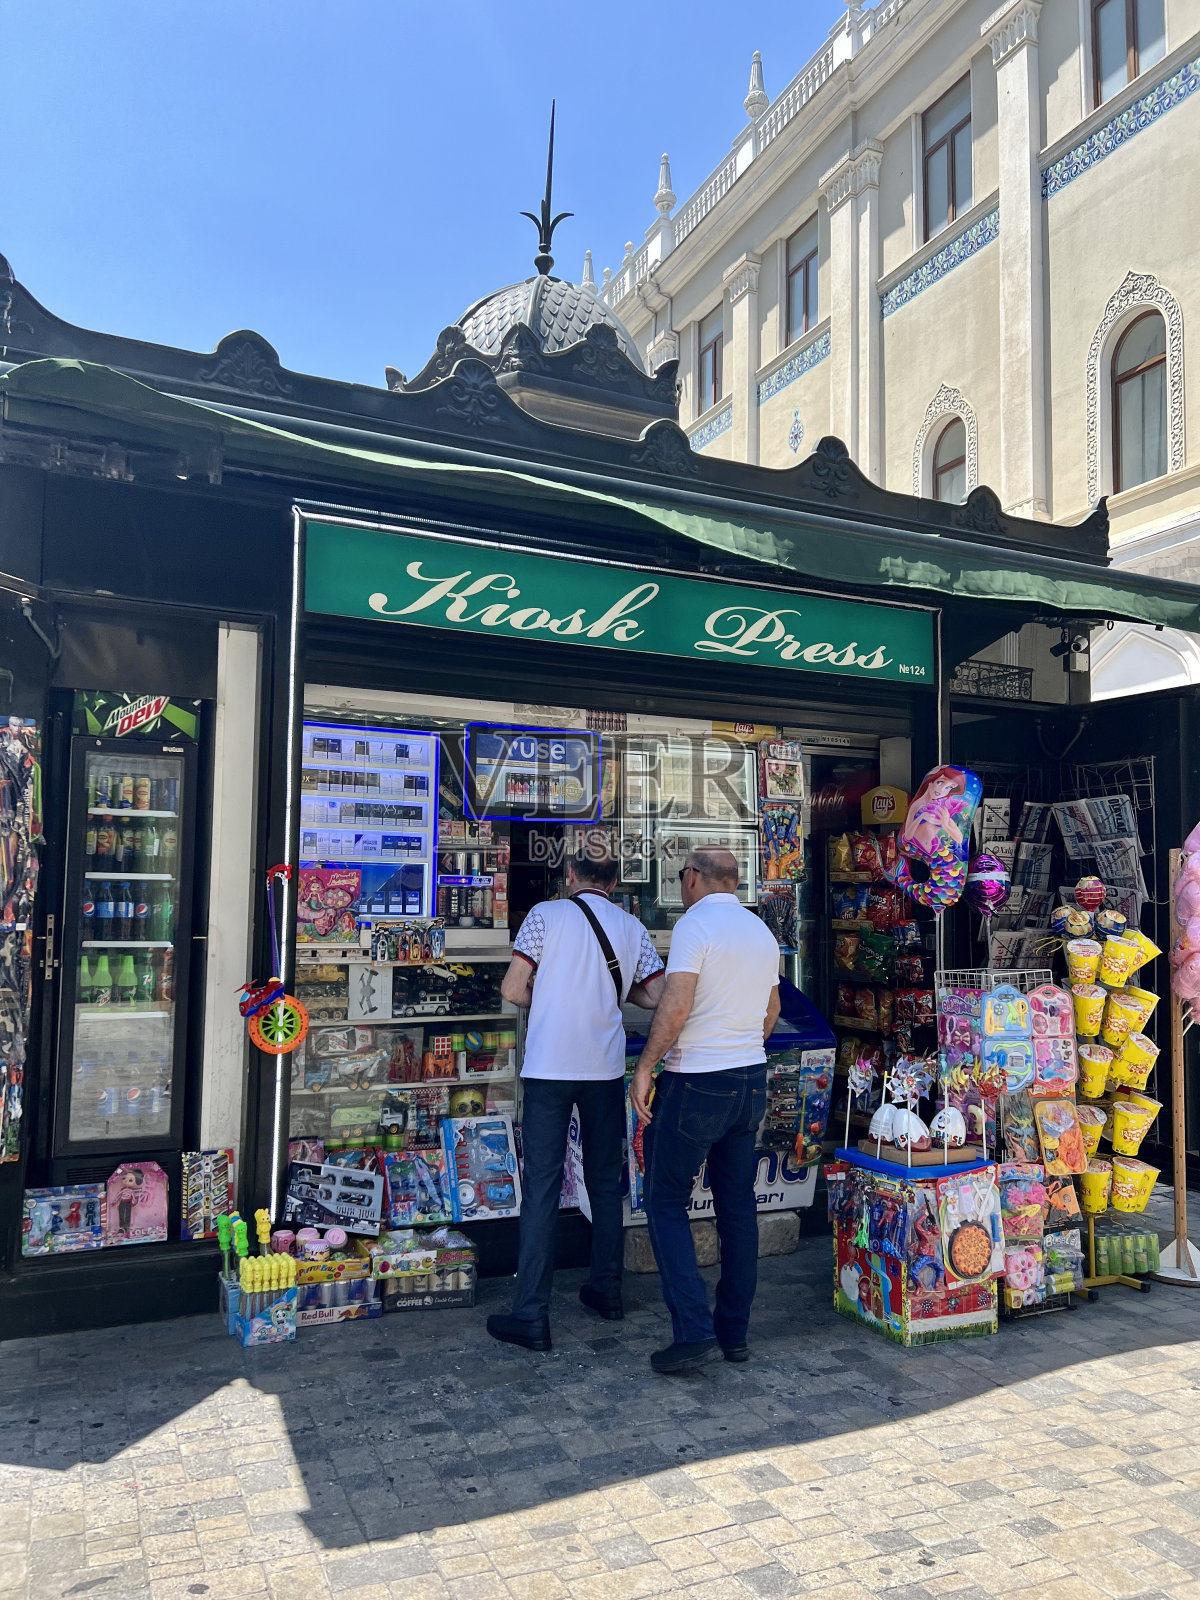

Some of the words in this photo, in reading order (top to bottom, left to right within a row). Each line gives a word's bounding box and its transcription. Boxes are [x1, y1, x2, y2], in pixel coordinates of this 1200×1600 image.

[367, 560, 661, 643] Kiosk
[695, 606, 893, 670] Press
[301, 1310, 318, 1321] Red
[318, 1308, 334, 1319] Bull
